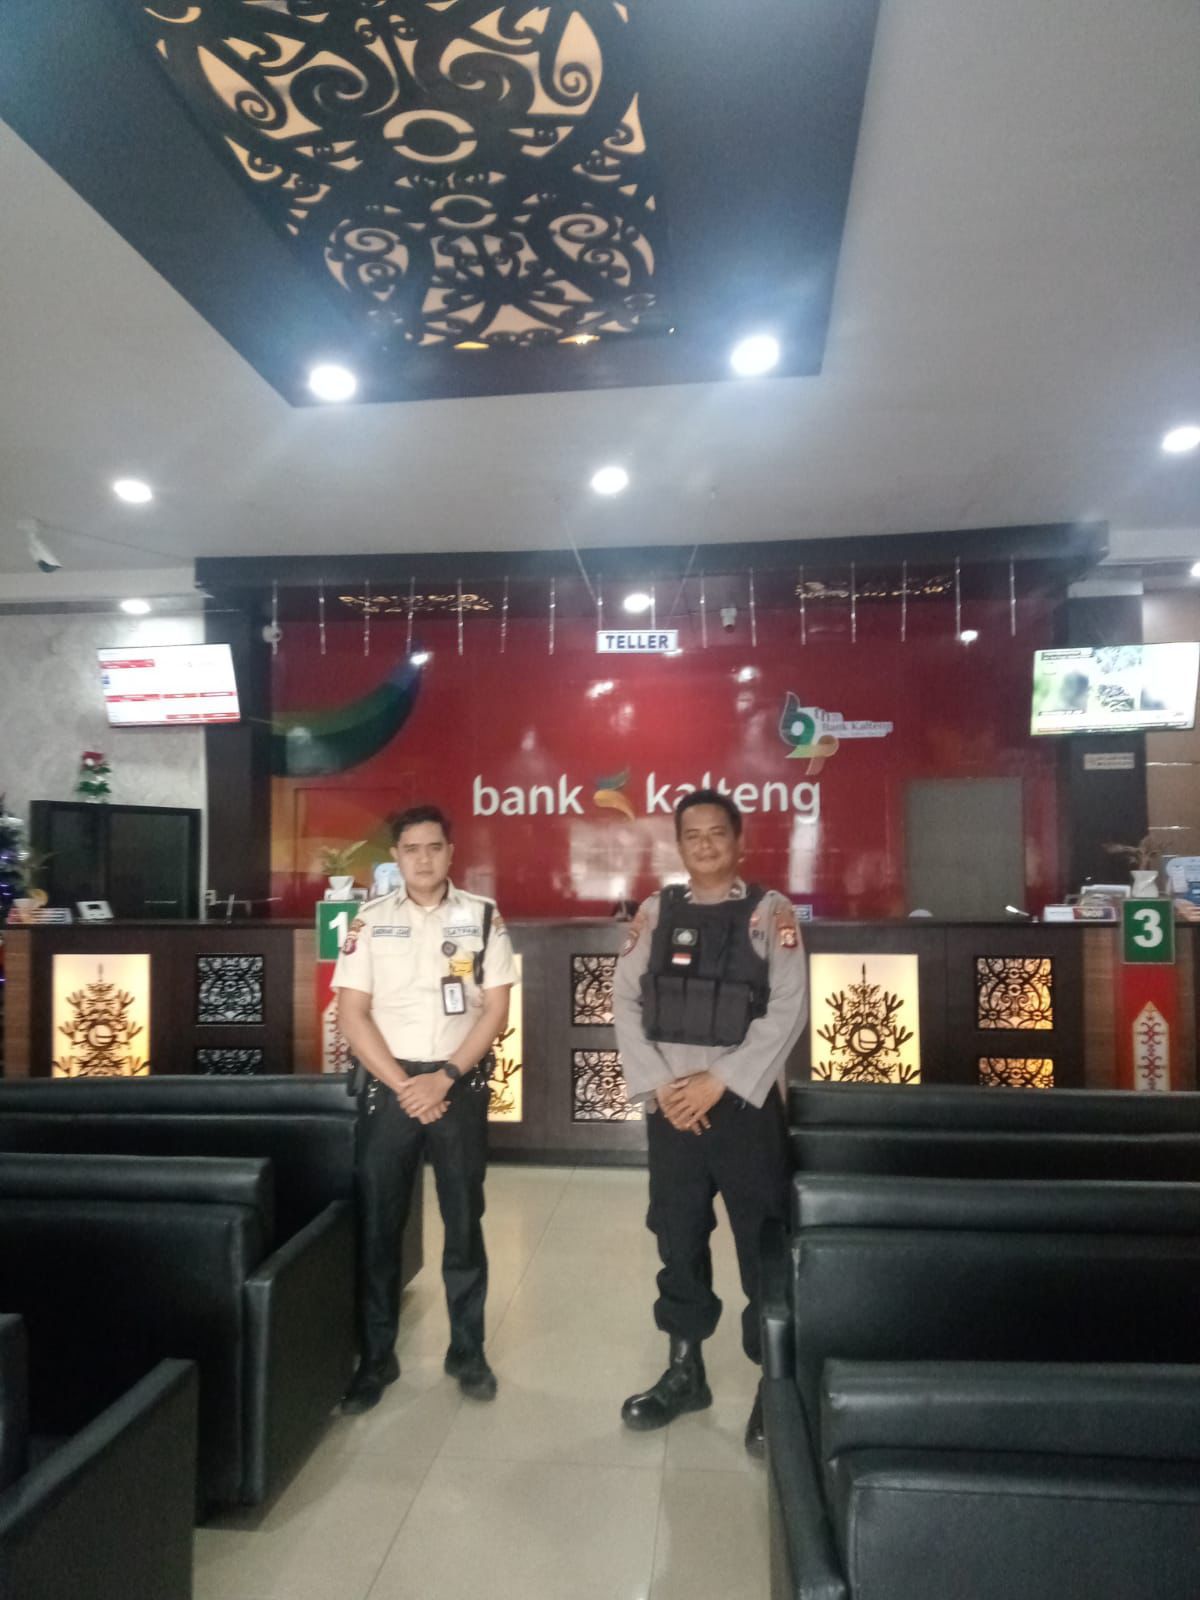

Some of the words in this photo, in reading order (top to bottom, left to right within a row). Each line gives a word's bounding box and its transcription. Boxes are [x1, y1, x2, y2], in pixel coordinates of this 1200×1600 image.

[606, 635, 668, 649] TELLER
[472, 773, 584, 816] bank
[328, 911, 348, 948] 1
[1133, 908, 1163, 948] 3
